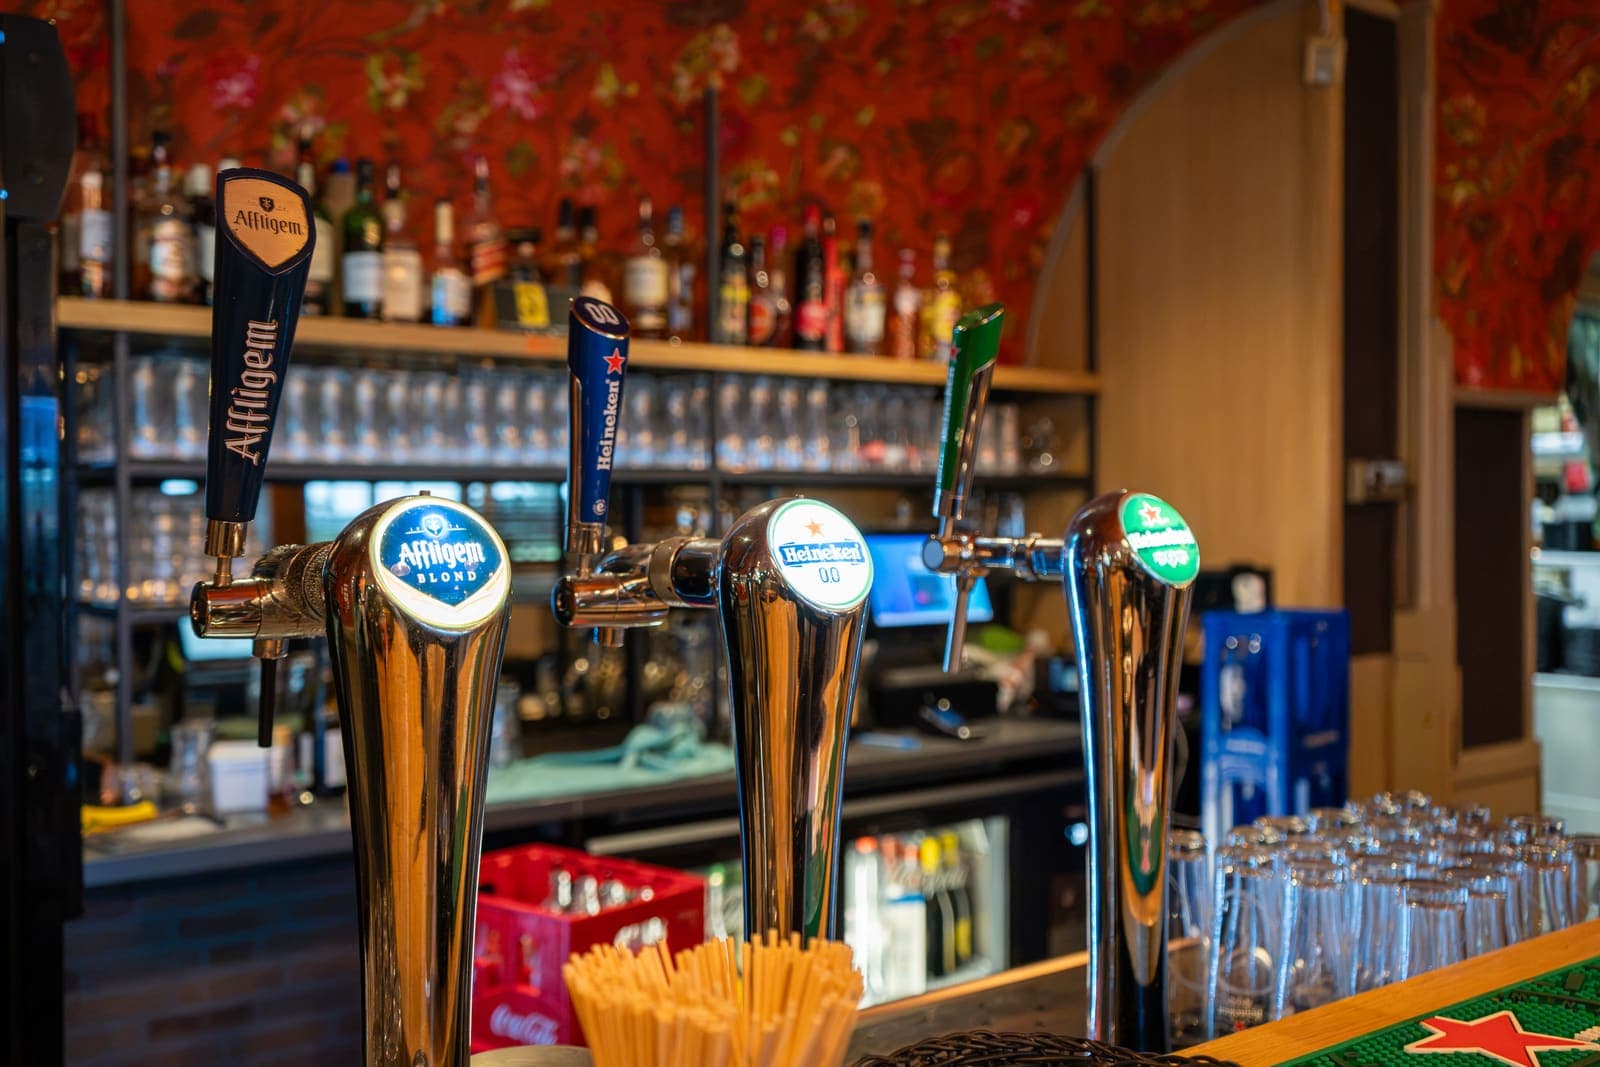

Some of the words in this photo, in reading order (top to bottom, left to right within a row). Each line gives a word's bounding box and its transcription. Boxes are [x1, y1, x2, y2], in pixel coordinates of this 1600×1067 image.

[233, 210, 302, 235] Affligem
[224, 320, 278, 466] Affligem
[596, 380, 619, 471] Heineken
[399, 540, 485, 569] Affligem
[783, 543, 861, 562] Heineken
[417, 571, 477, 584] BLOND
[819, 567, 840, 583] 0.0
